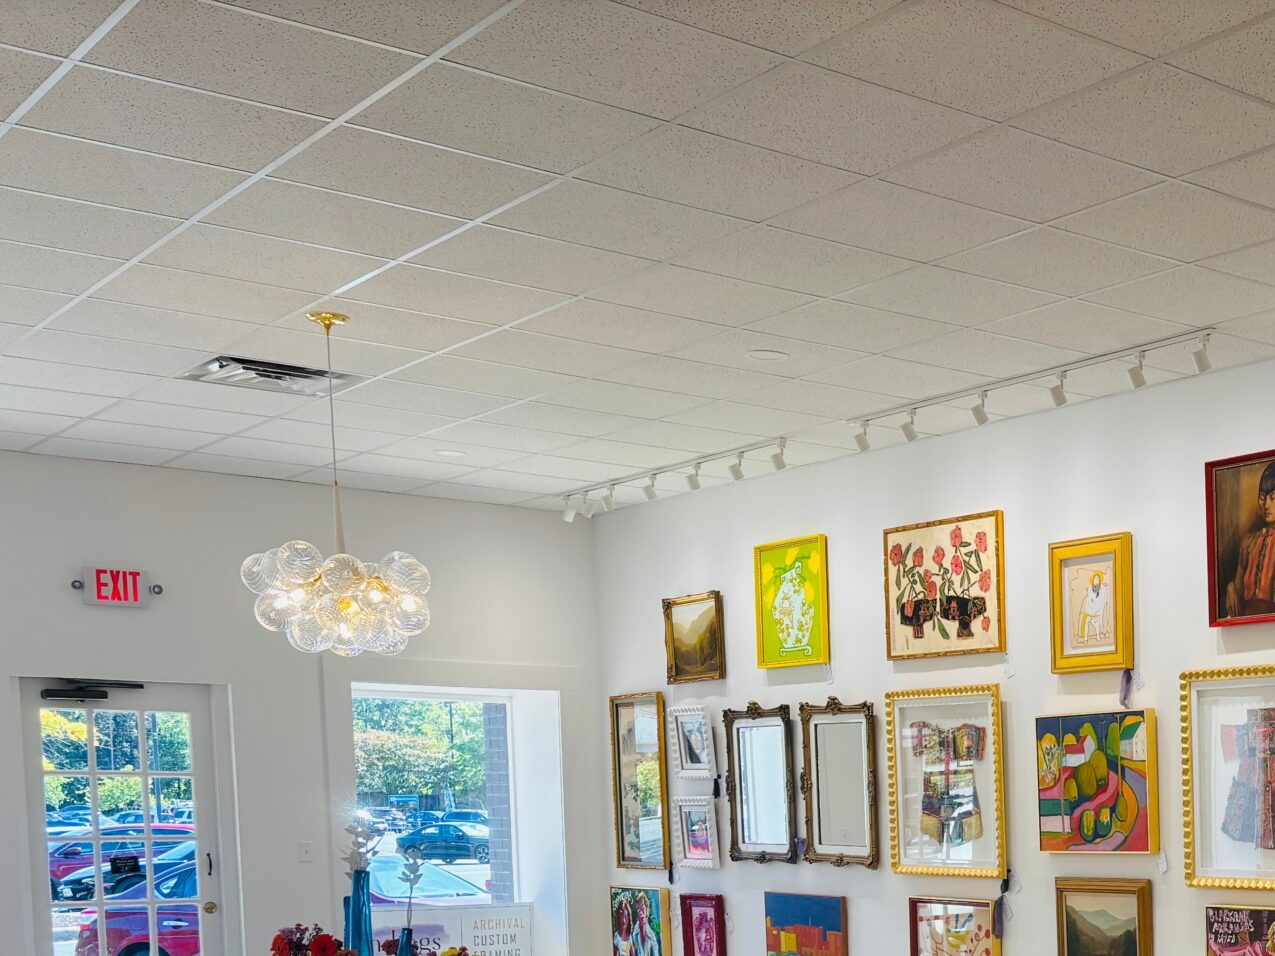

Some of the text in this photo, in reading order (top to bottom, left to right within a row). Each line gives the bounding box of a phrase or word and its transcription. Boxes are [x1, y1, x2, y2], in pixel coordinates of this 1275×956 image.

[96, 569, 140, 602] EXIT
[473, 918, 525, 931] ARCHIVAL
[473, 933, 517, 946] CUSTOM
